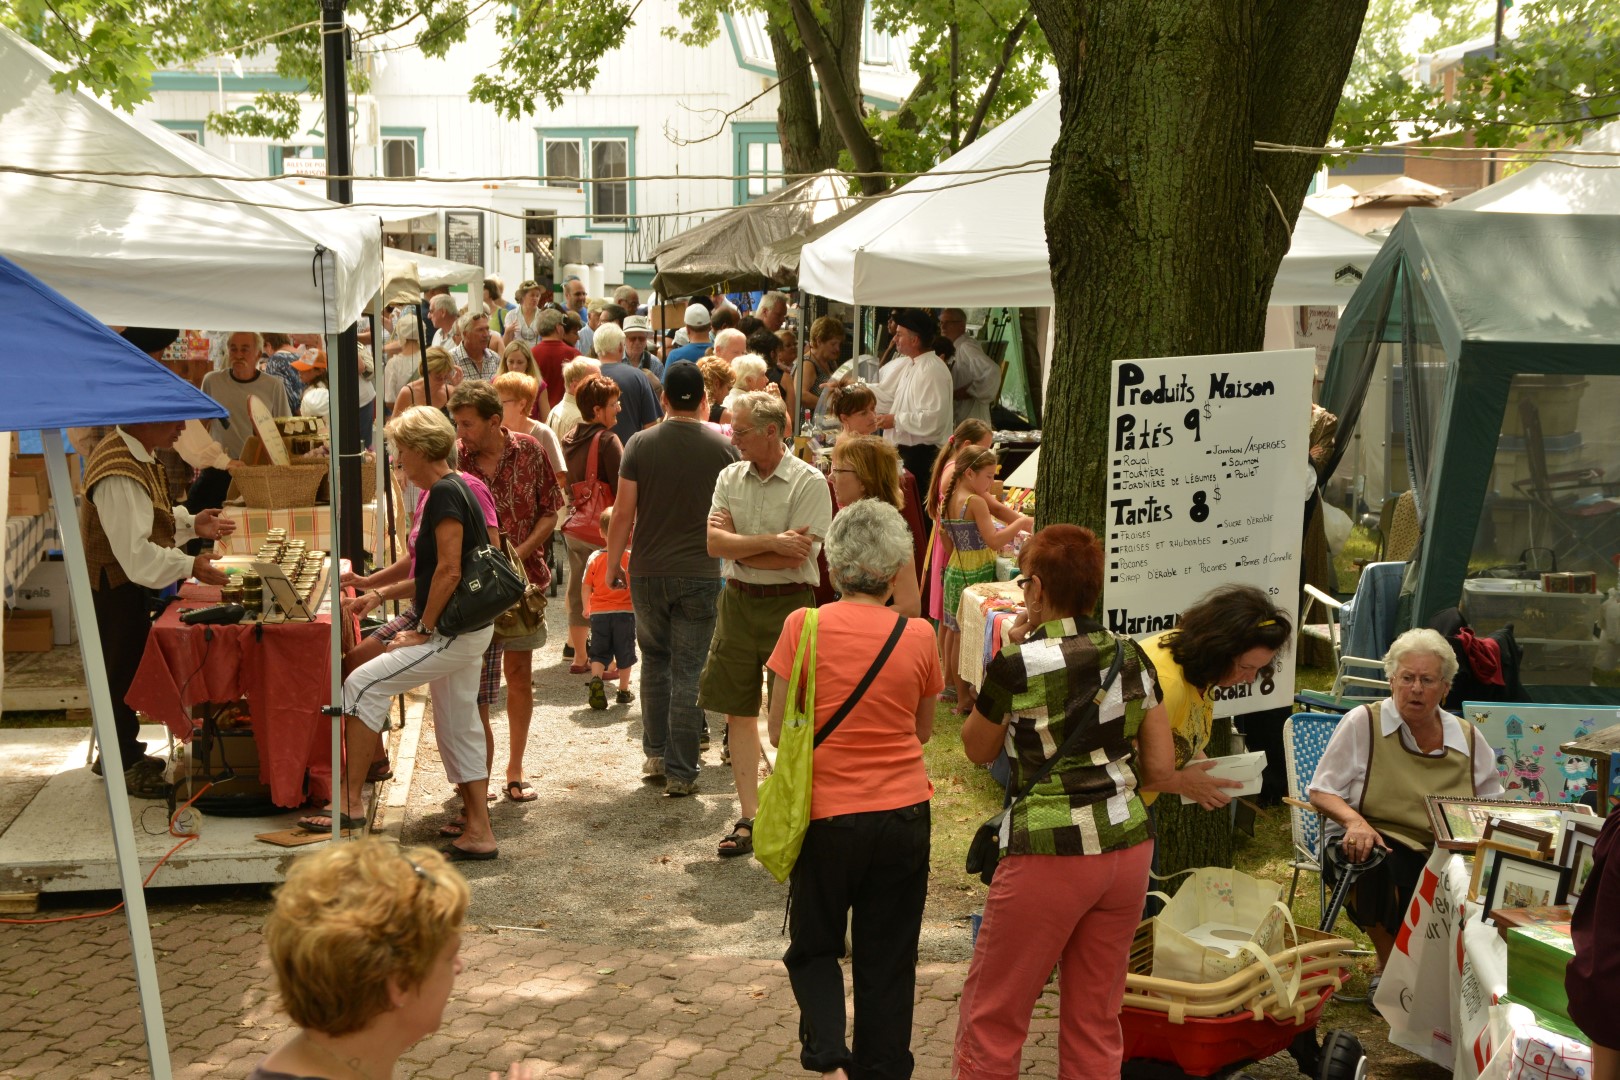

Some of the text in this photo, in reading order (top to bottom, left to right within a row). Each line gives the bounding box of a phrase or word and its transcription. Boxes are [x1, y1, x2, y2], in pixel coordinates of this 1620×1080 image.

[1117, 363, 1275, 407] Produits Maison
[1122, 452, 1150, 470] Royal
[1268, 587, 1280, 596] 50
[1107, 608, 1183, 635] Marina
